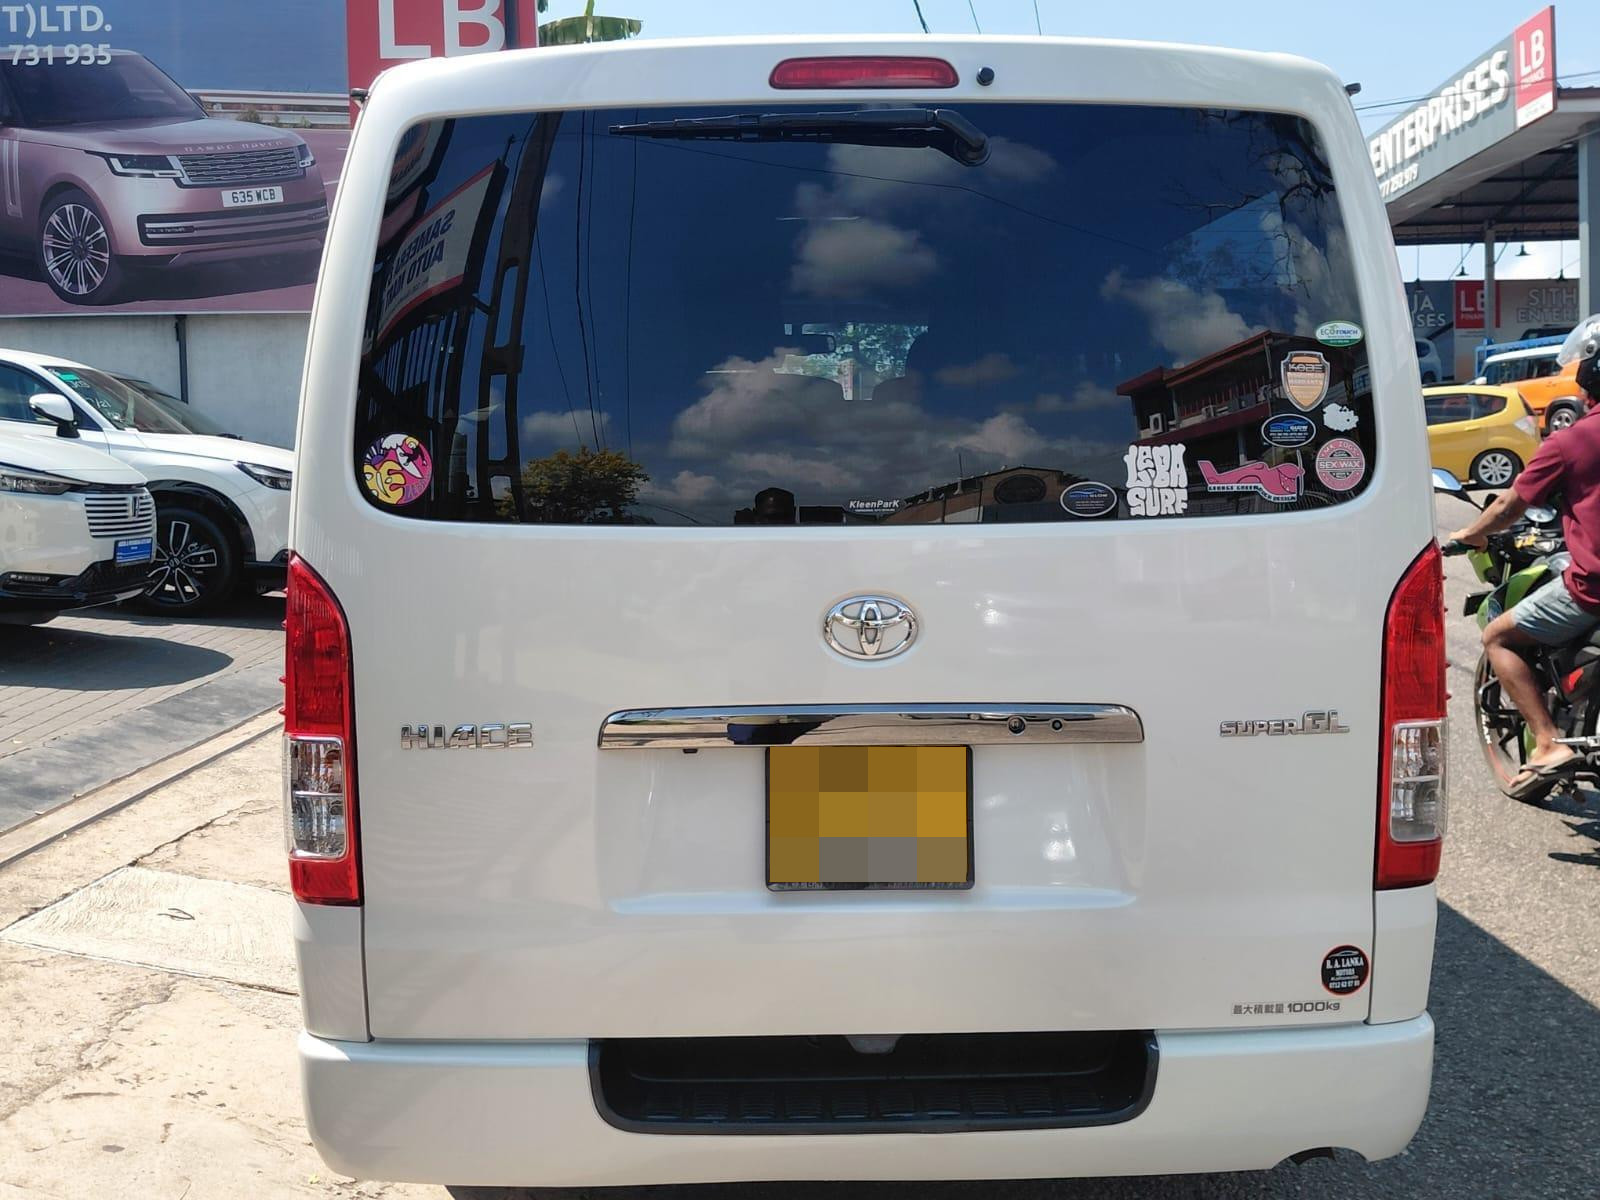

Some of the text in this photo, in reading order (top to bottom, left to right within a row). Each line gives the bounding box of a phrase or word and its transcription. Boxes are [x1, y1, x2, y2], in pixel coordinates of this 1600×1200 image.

[378, 0, 506, 59] LB
[8, 43, 112, 66] 731 935
[1519, 29, 1545, 77] LB
[1369, 49, 1509, 178] ENTERPRISES
[231, 188, 276, 203] 635 WCB
[1517, 308, 1579, 323] ENTER
[1319, 461, 1361, 469] SEX WAX
[1126, 487, 1188, 517] SURF
[401, 723, 534, 750] HIACE
[1341, 956, 1364, 968] LANKA
[1233, 1001, 1340, 1015] 最大積載量 1000kg
